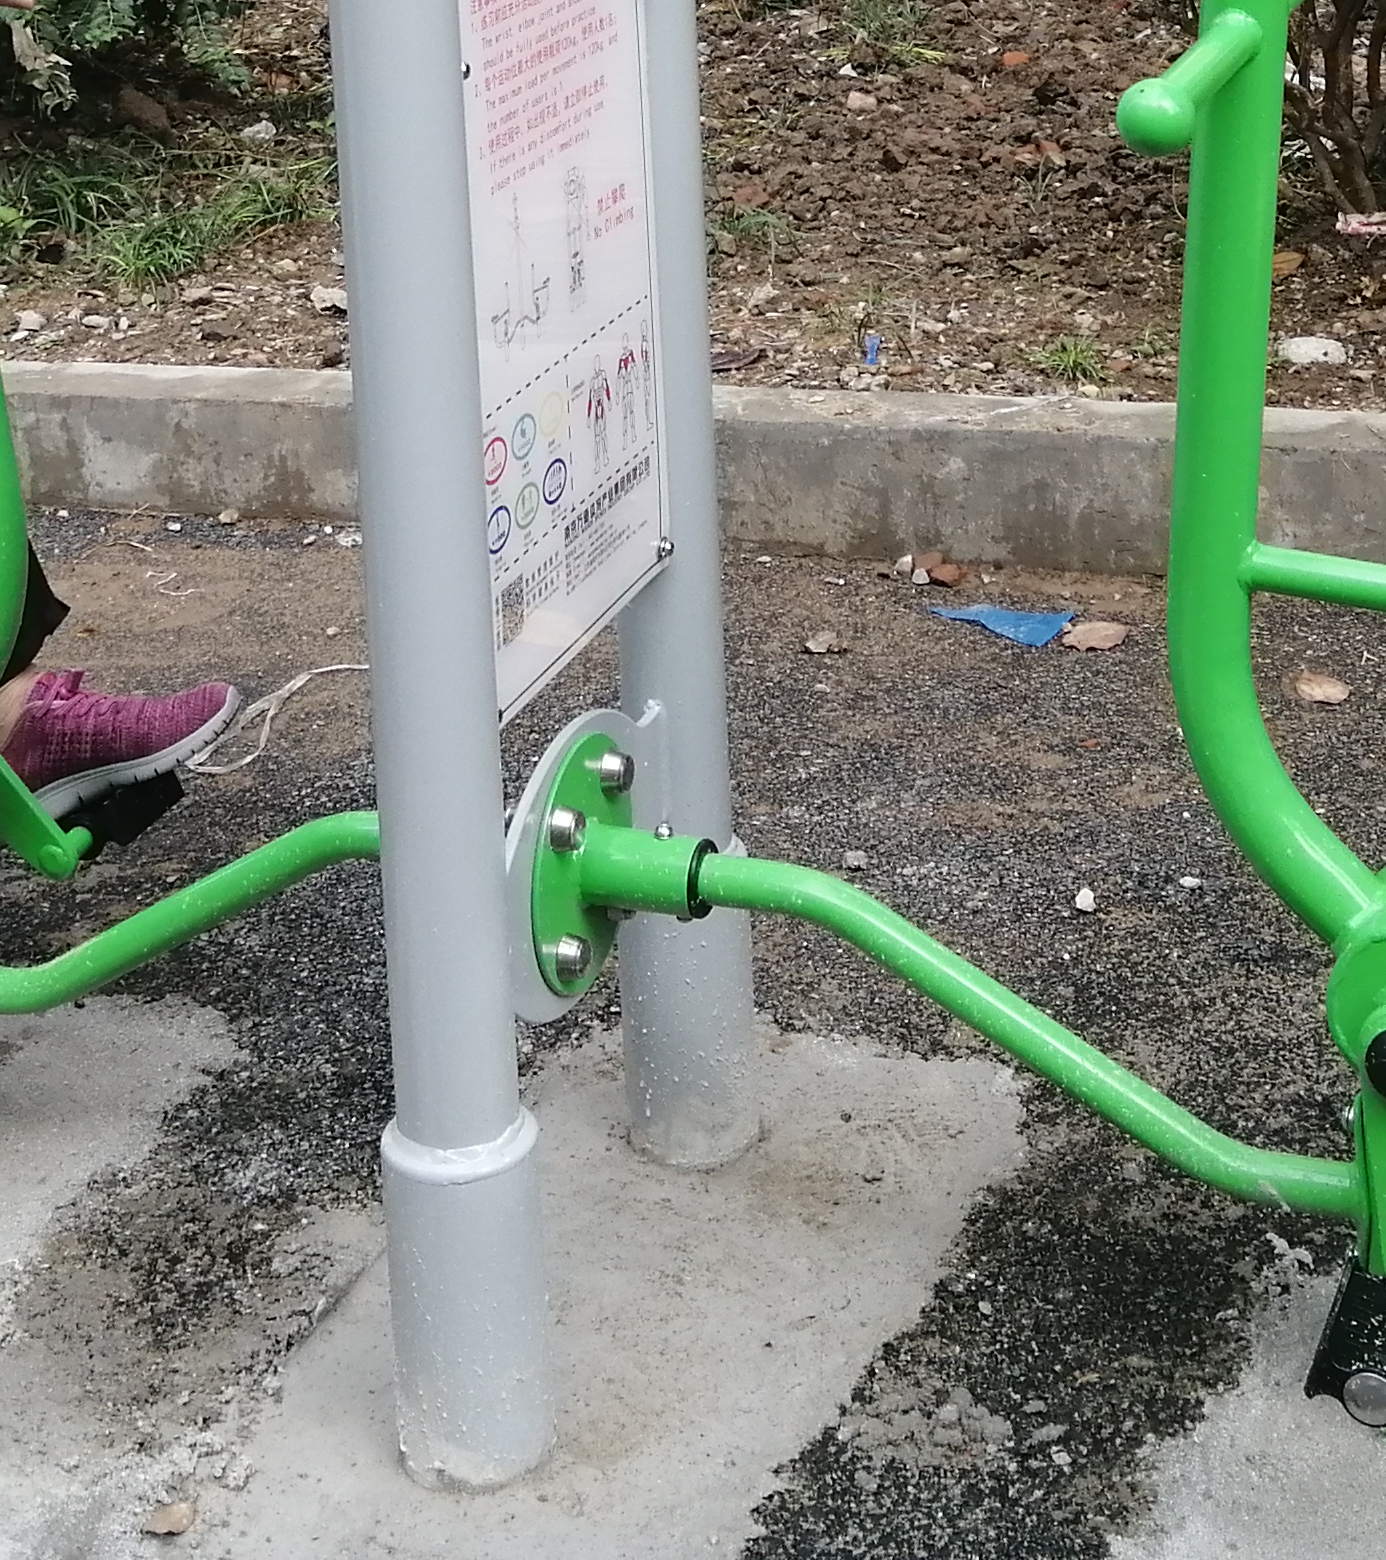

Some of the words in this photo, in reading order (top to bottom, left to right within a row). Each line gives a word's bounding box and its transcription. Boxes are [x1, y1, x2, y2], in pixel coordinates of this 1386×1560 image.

[482, 36, 493, 50] The
[518, 15, 535, 32] elbow
[538, 7, 554, 26] joint
[483, 53, 504, 71] should
[506, 48, 514, 59] be
[516, 37, 533, 54] fully
[535, 30, 549, 45] used
[551, 19, 570, 38] before
[486, 99, 496, 112] The
[498, 85, 522, 105] maximum
[525, 74, 538, 90] load
[539, 70, 550, 84] per
[552, 55, 578, 76] movement
[580, 50, 586, 61] is
[608, 30, 618, 46] and
[487, 120, 497, 133] the
[499, 107, 519, 127] number
[522, 99, 529, 114] of
[531, 92, 548, 108] users
[551, 86, 557, 97] is
[490, 159, 497, 173] If
[499, 151, 516, 168] there
[519, 146, 525, 156] is
[527, 138, 538, 153] any
[540, 117, 572, 144] discomfort
[573, 106, 592, 125] during
[491, 176, 511, 196] please
[513, 166, 526, 182] stop
[528, 154, 546, 172] using
[548, 148, 554, 160] it
[594, 226, 603, 240] No
[605, 206, 634, 233] Climbing
[597, 183, 625, 216] 禁止攀爬
